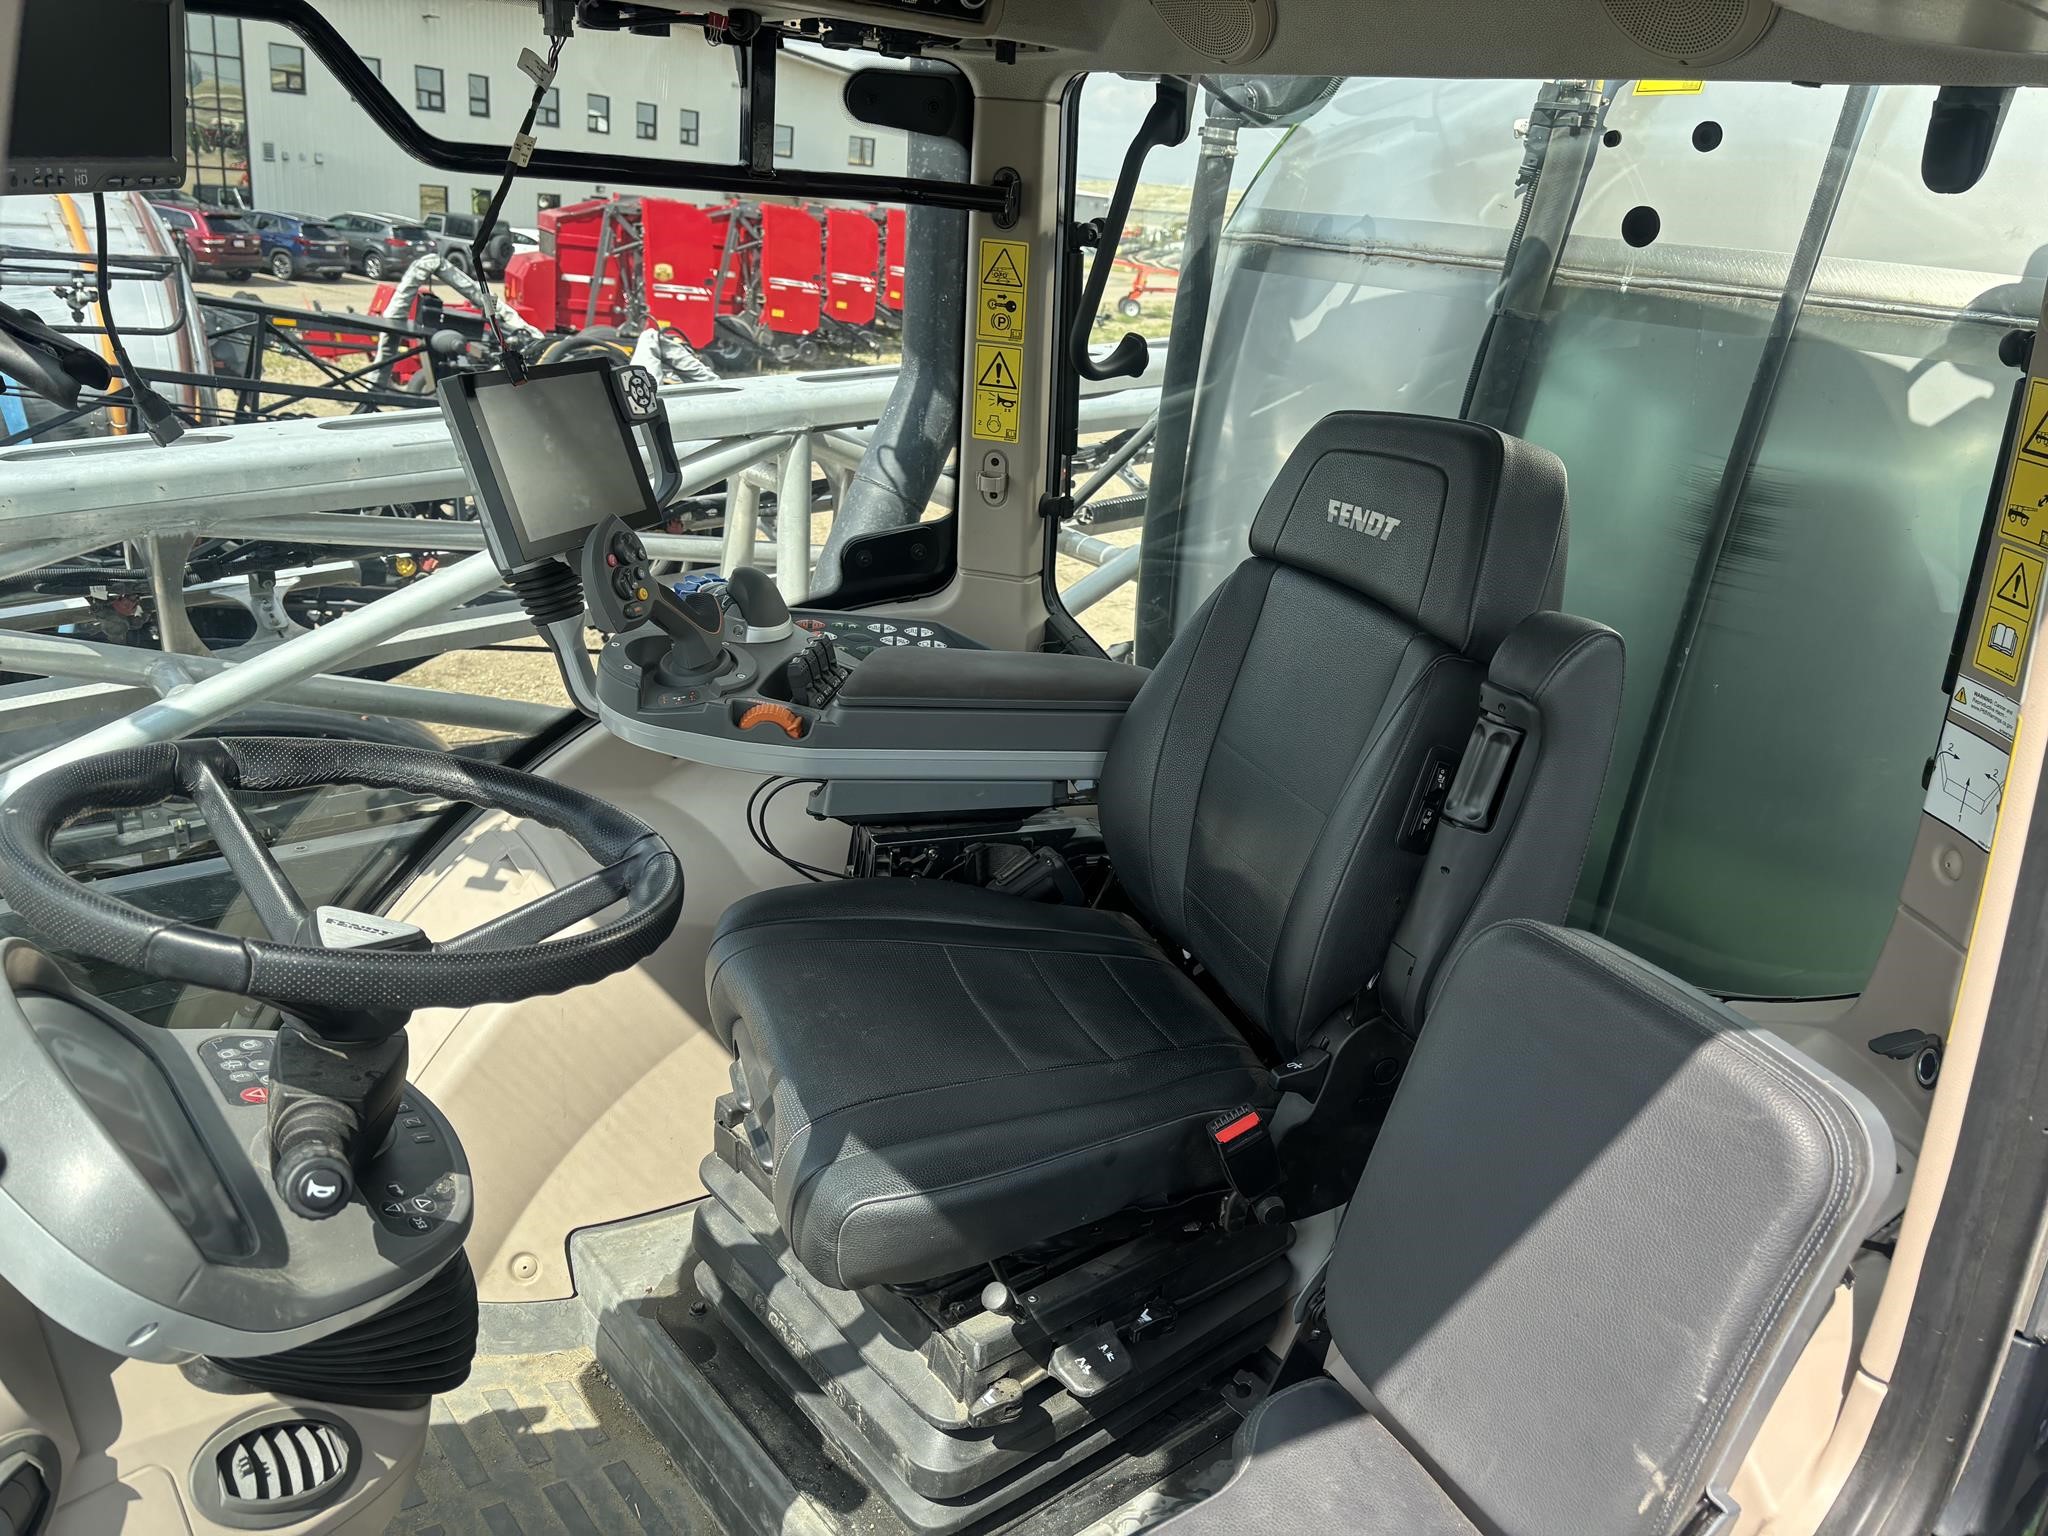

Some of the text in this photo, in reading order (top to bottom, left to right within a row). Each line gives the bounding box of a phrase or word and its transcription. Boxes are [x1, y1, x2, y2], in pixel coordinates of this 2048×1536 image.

[74, 175, 88, 187] HD
[997, 316, 1006, 327] P
[1327, 499, 1401, 541] FENDT
[1993, 701, 2008, 711] Cancer
[1947, 742, 1954, 752] 2
[1992, 768, 1999, 778] 2
[325, 917, 394, 936] FENDT
[411, 1216, 428, 1230] ESC
